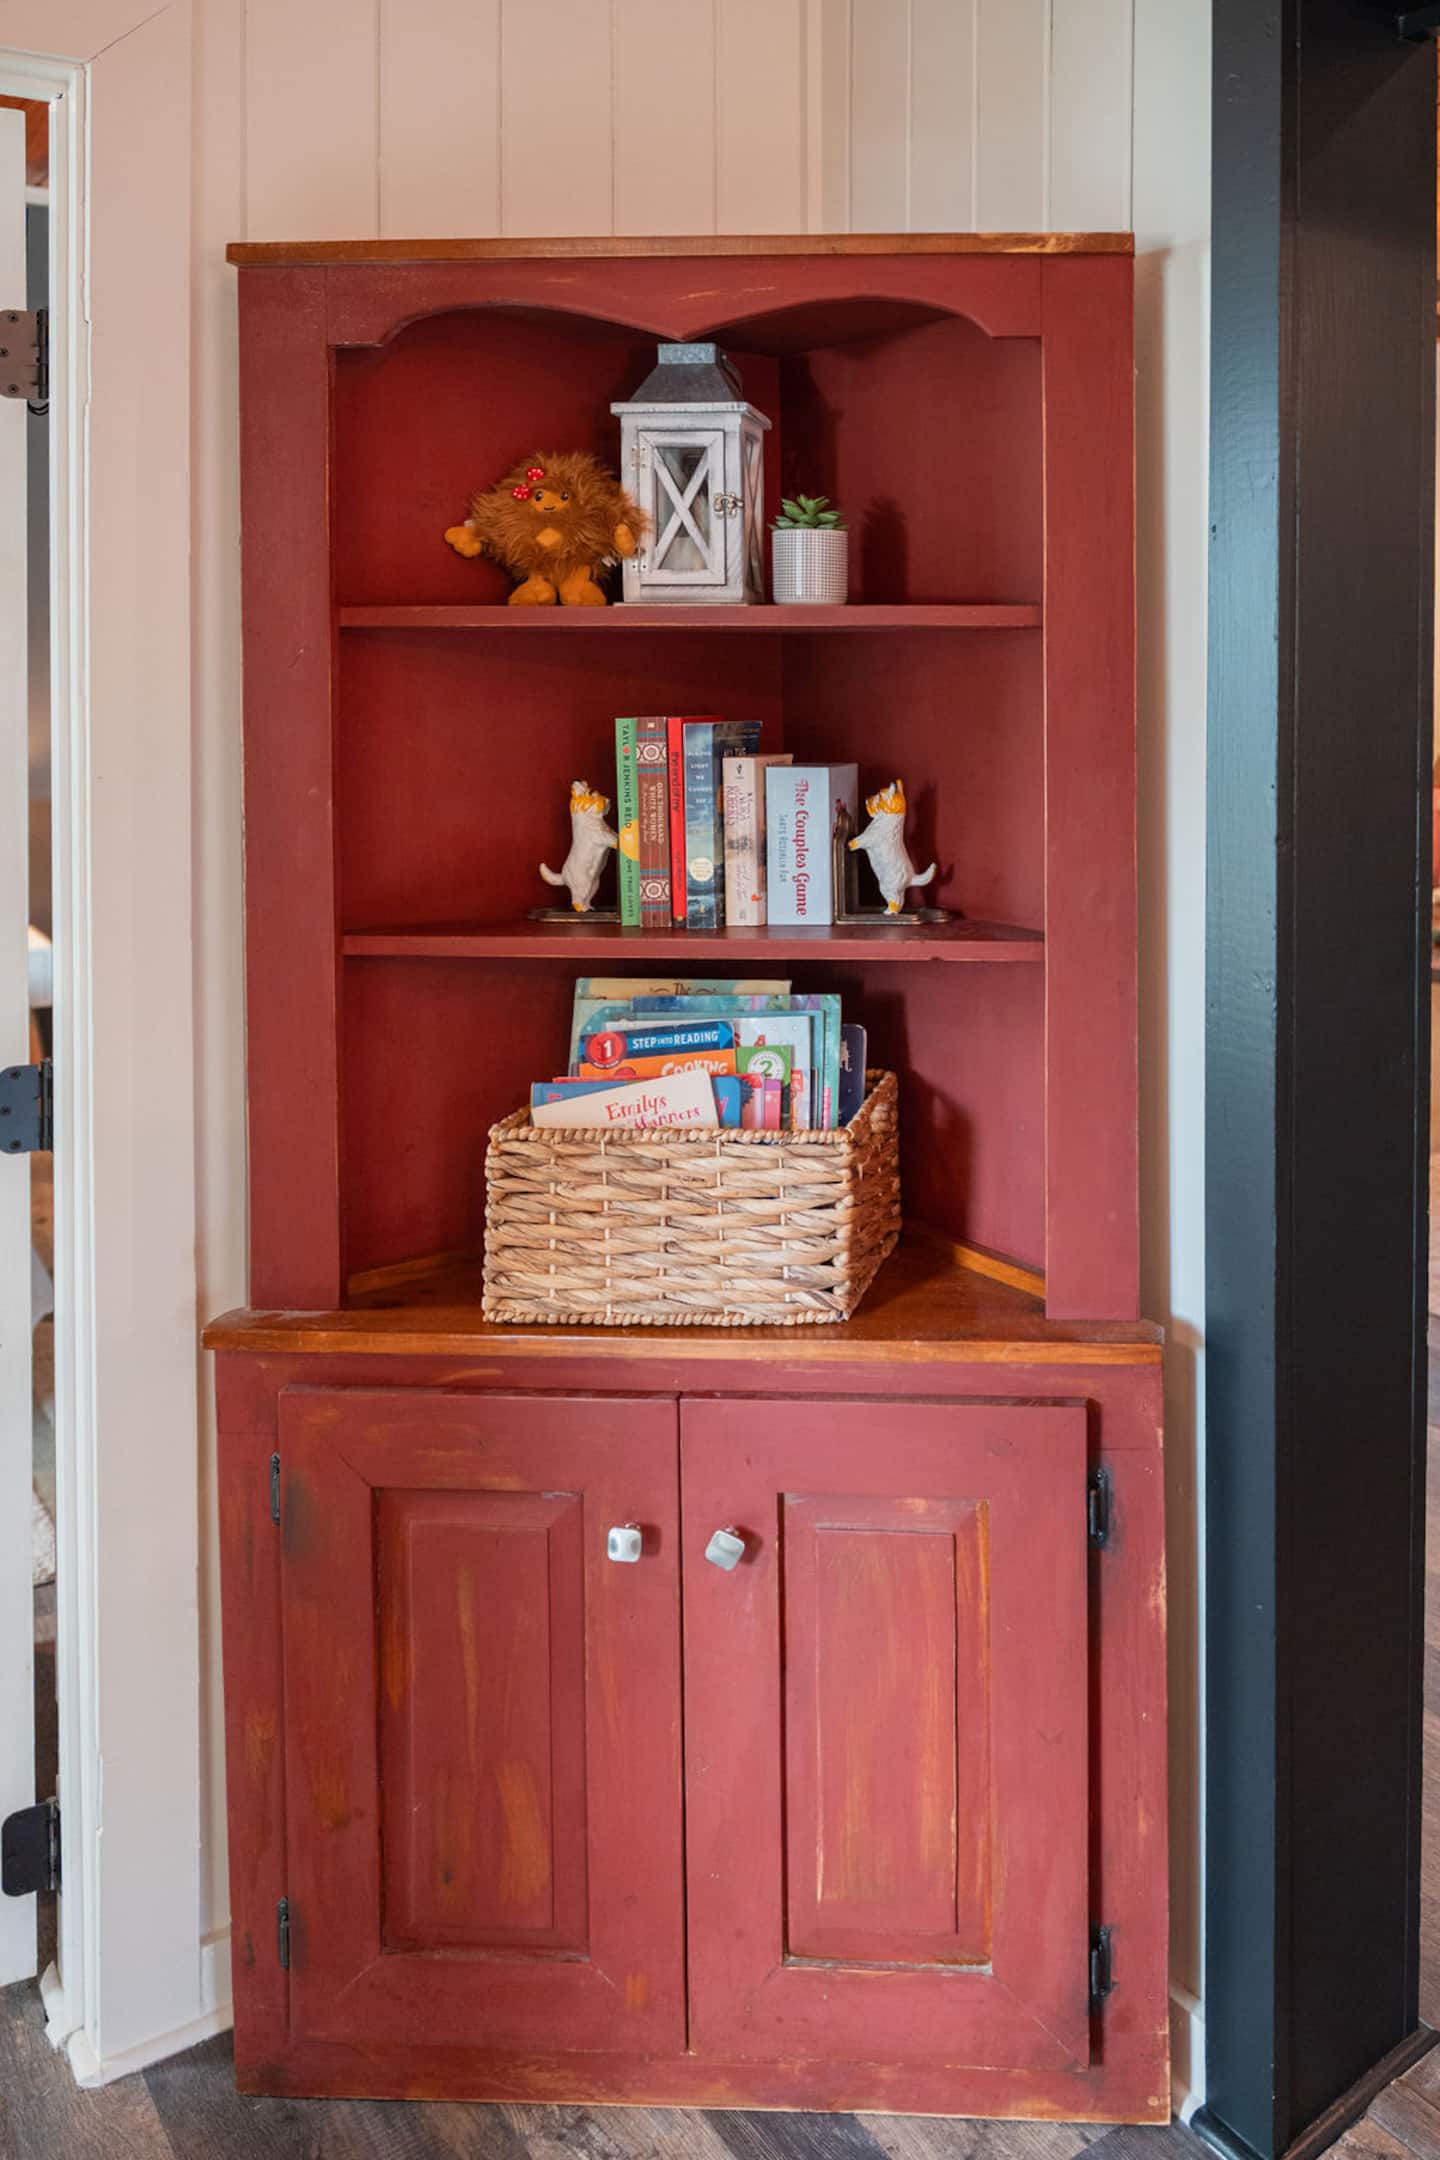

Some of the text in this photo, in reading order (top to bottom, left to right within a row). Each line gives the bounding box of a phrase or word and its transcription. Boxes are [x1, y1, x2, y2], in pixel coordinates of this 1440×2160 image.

[623, 764, 633, 804] JENKINS
[624, 806, 633, 829] REID
[792, 778, 810, 916] The Couples Game
[603, 1039, 612, 1058] 1
[632, 1037, 657, 1049] STEP
[673, 1030, 719, 1045] READING
[760, 1060, 773, 1077] 2
